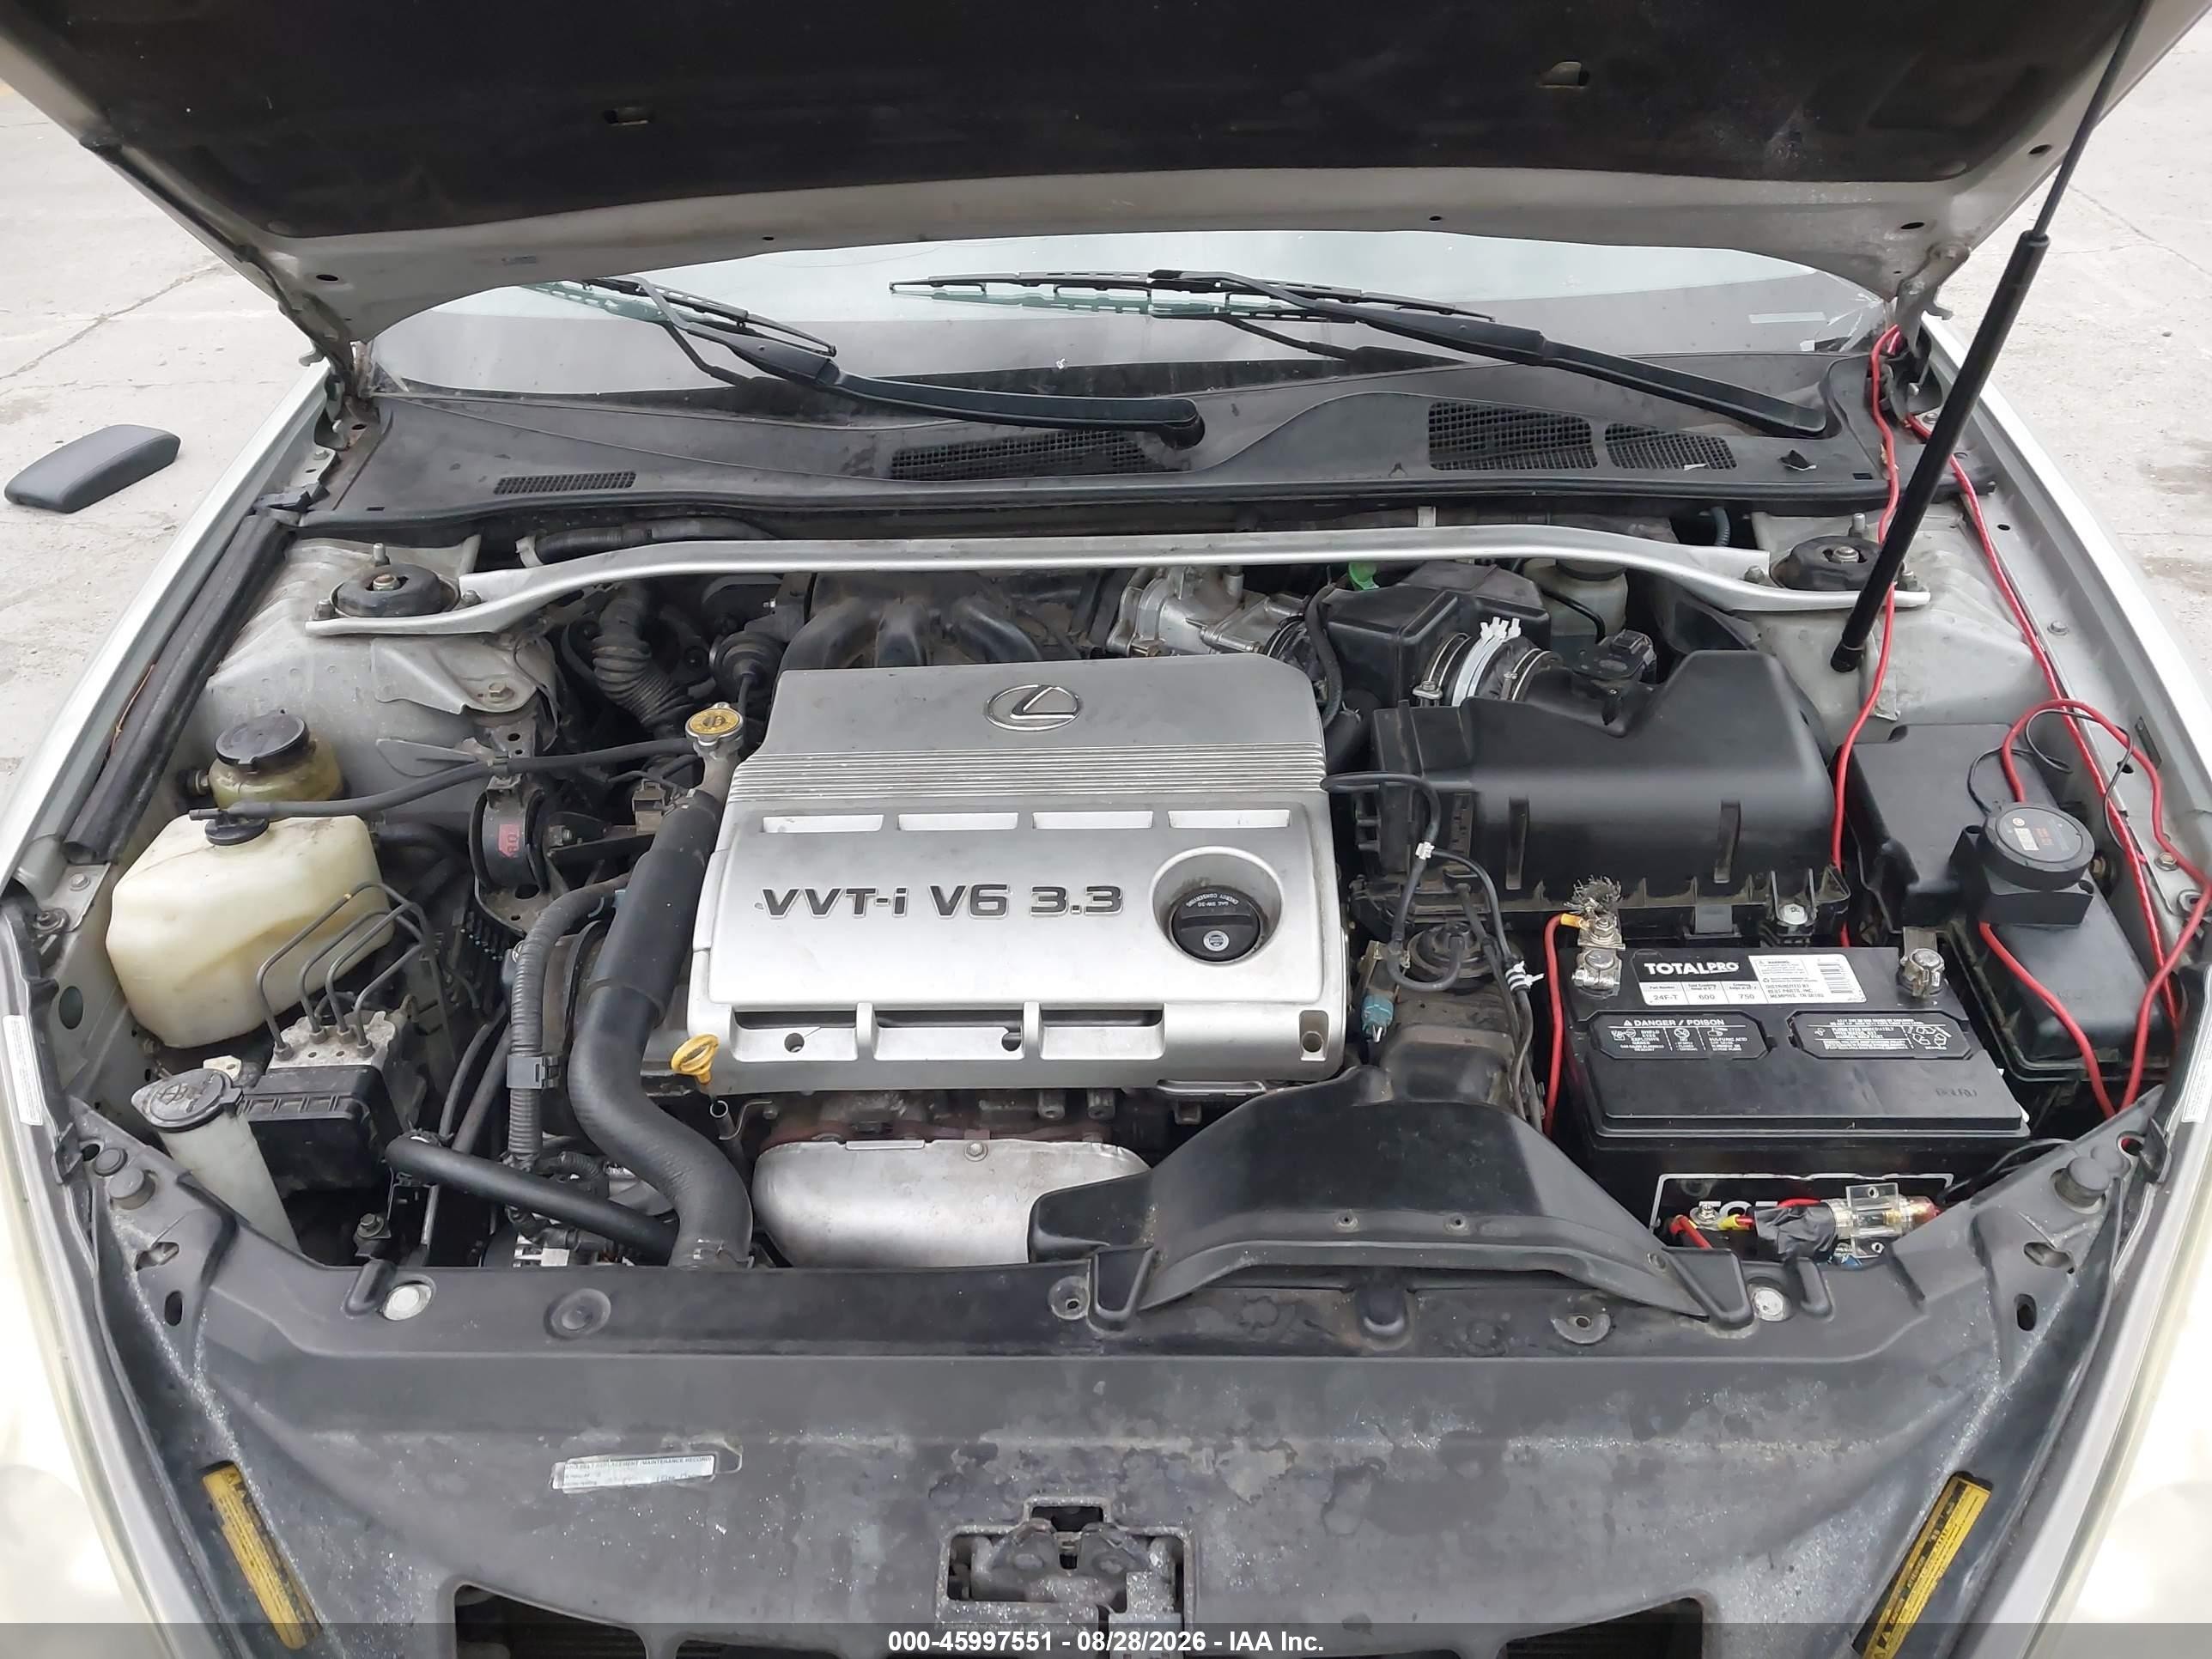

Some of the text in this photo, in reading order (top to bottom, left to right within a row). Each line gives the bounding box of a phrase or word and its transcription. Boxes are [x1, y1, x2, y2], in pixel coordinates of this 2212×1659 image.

[761, 884, 1124, 921] VVT-i V6 3.3
[1644, 962, 1740, 975] TOTALPRO
